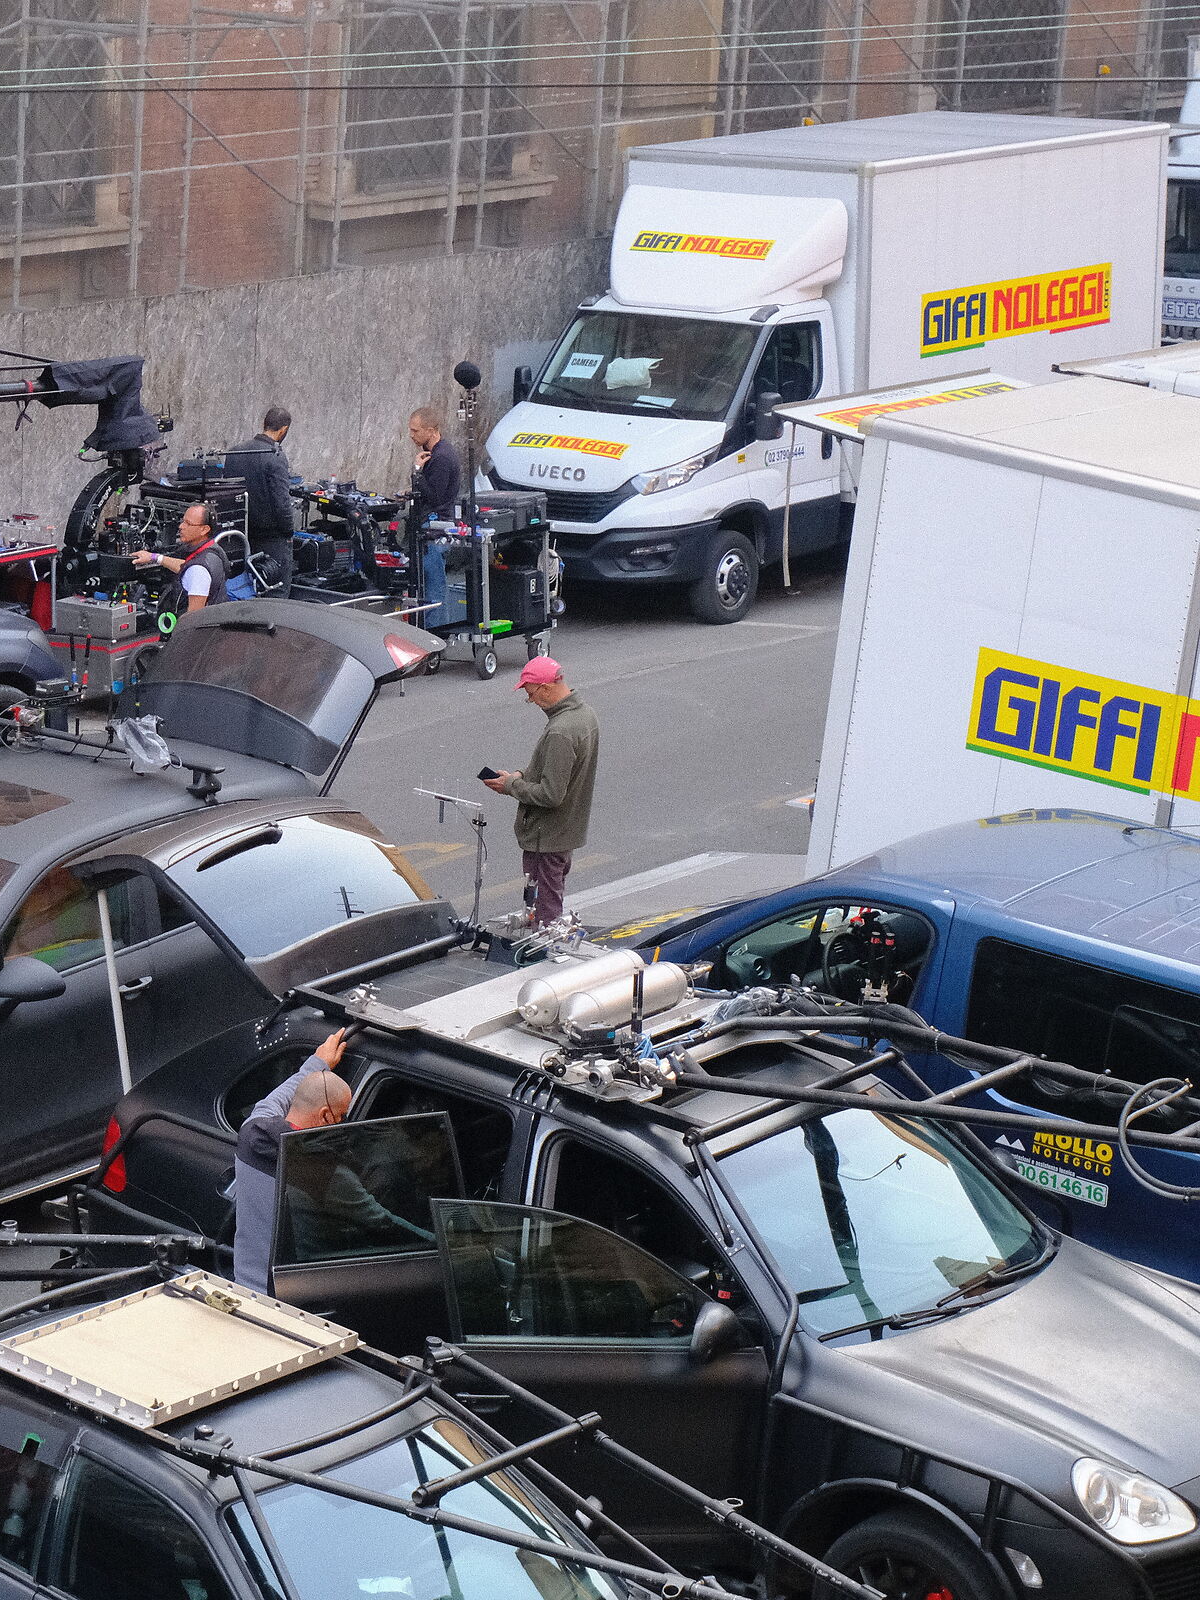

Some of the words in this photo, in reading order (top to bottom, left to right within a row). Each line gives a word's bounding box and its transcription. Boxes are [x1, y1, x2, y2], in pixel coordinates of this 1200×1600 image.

[633, 232, 683, 250] GIFFI
[681, 236, 769, 257] NOLEGGI
[922, 291, 987, 347] GIFFI
[992, 271, 1104, 334] NOLEGGI
[571, 358, 598, 368] CAMERA
[510, 433, 553, 446] GIFFI
[550, 436, 624, 457] NOLEGGI
[529, 463, 586, 482] IVECO
[976, 666, 1162, 783] GIFFI
[1032, 1144, 1112, 1177] NOLEGGIO
[1033, 1132, 1114, 1163] MOLLO
